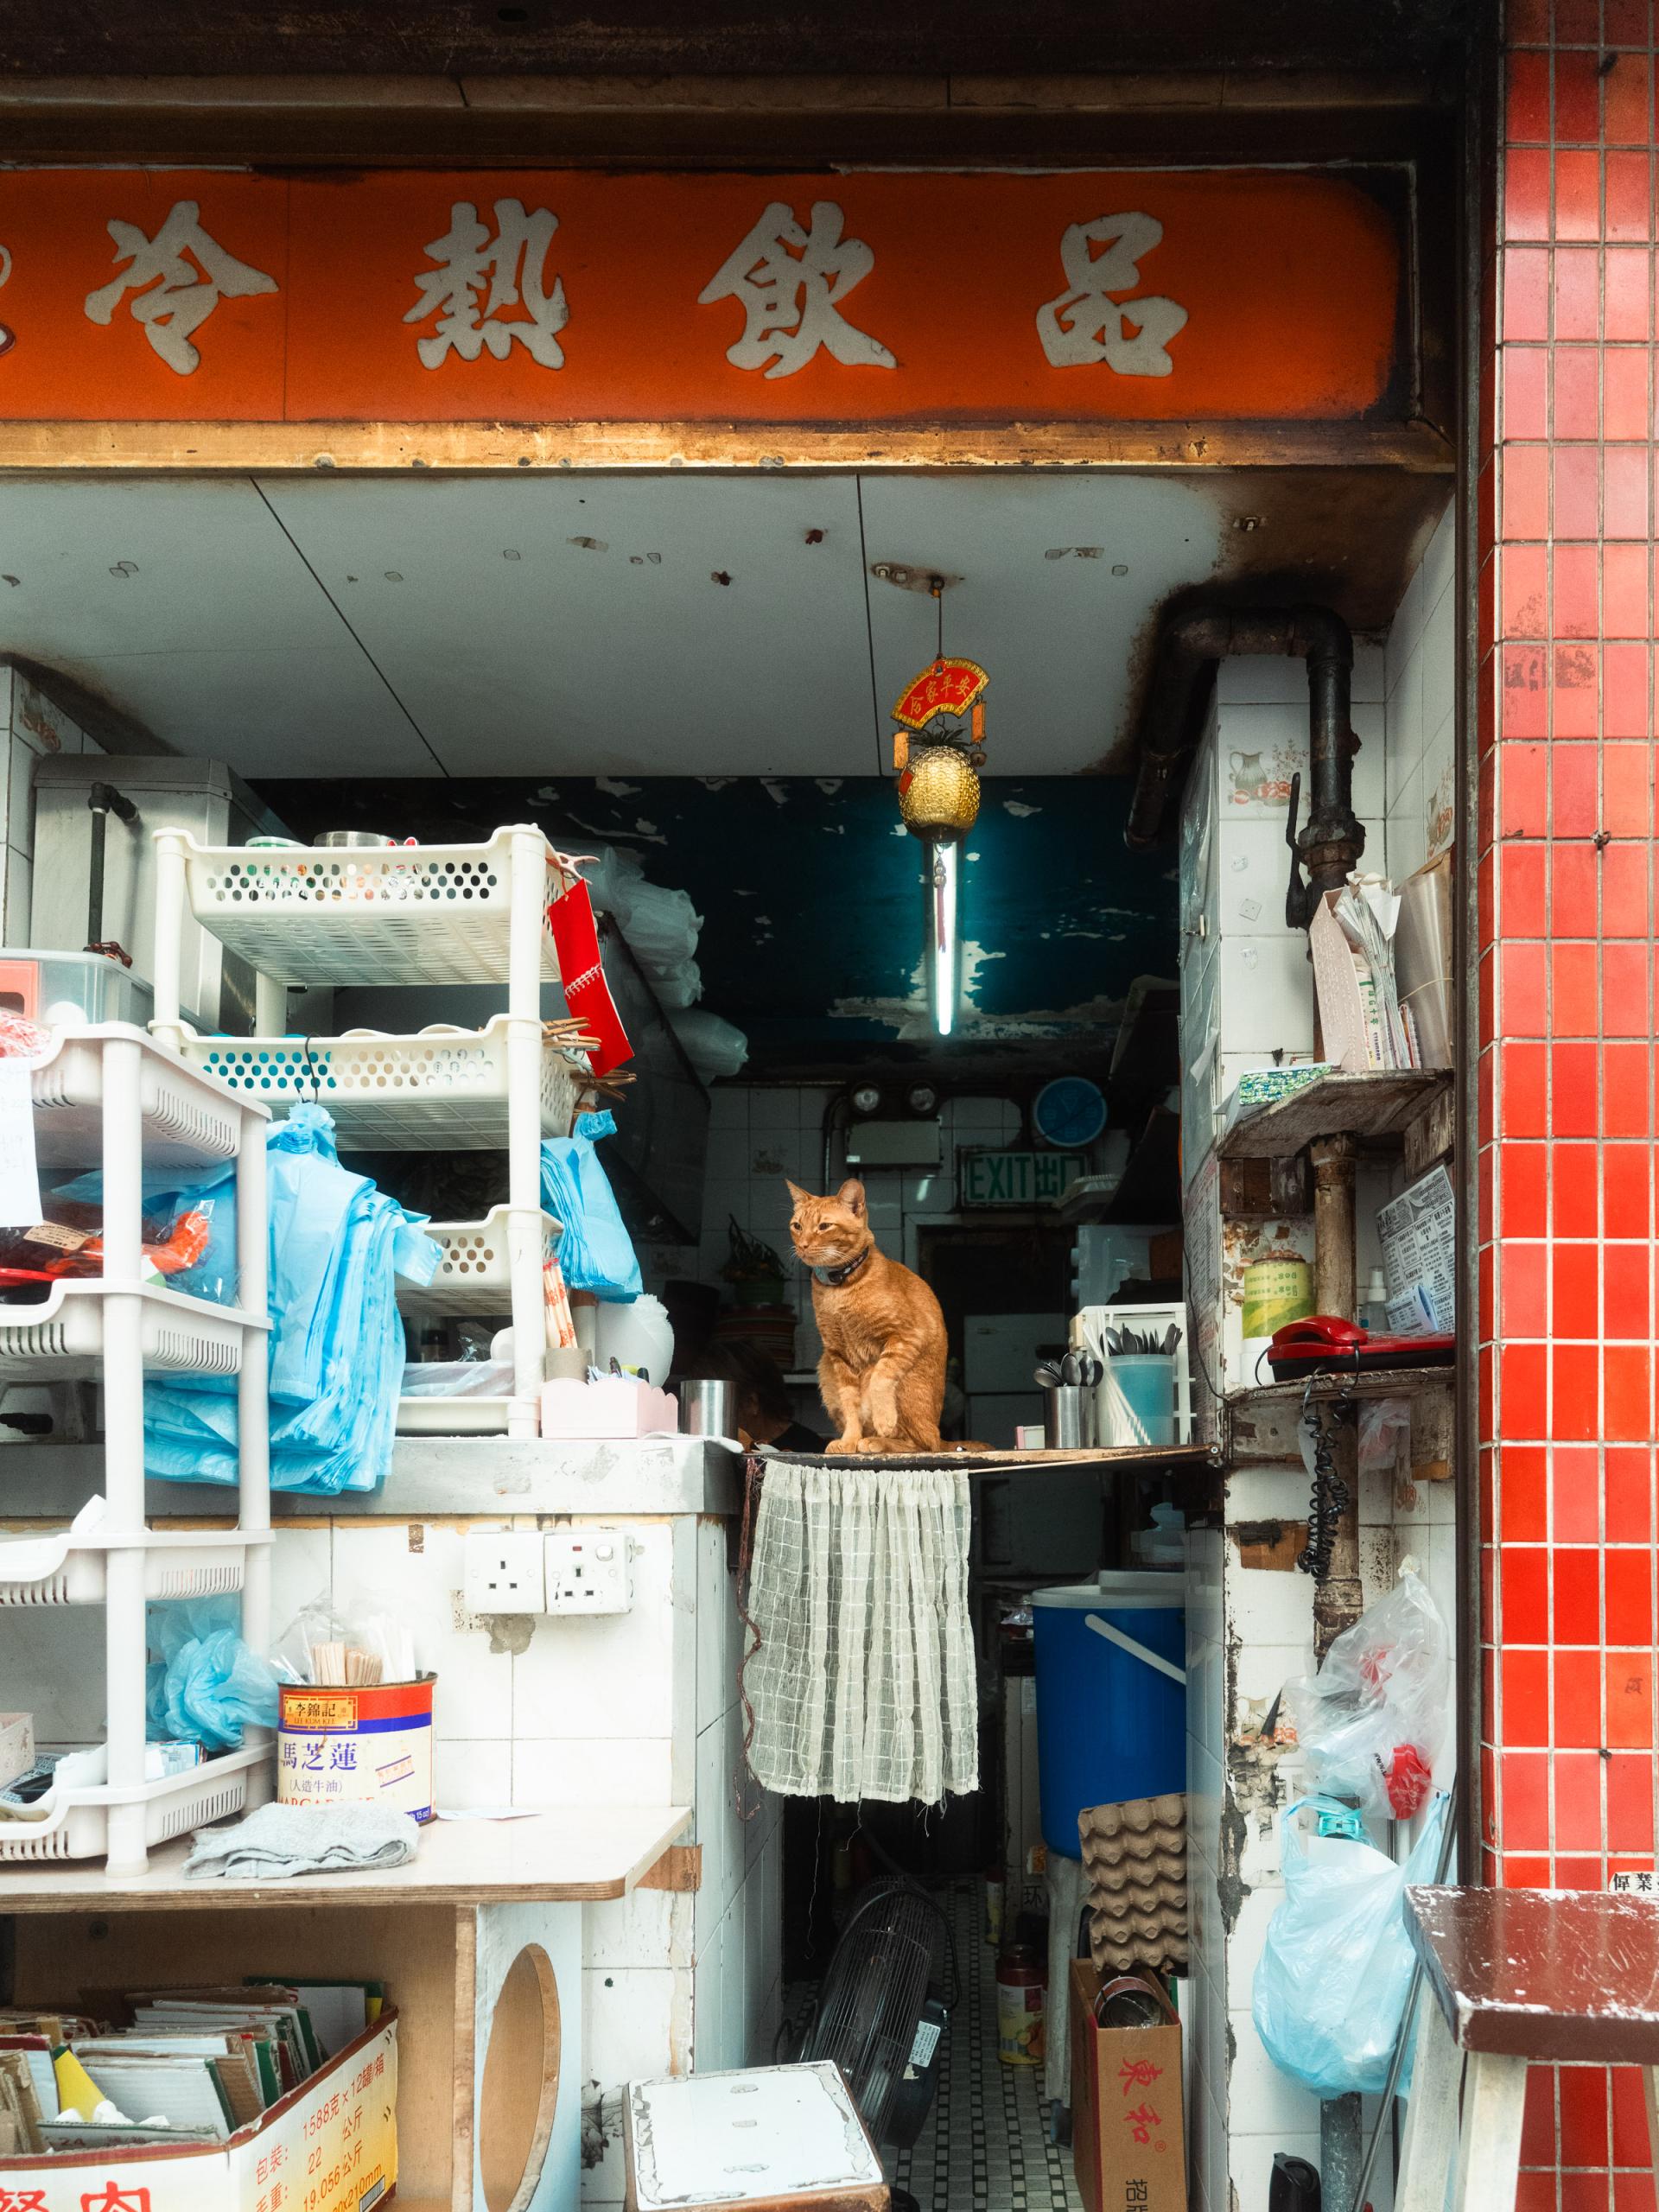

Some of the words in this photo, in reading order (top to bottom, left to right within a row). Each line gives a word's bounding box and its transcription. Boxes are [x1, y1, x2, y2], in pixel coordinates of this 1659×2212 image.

[84, 198, 1190, 379] 冷熱飲品
[969, 1156, 1031, 1199] EXIT
[1035, 1155, 1085, 1198] 出口
[296, 1702, 336, 1718] 李錦記
[282, 1742, 359, 1771] 馬芝蓮
[1118, 2056, 1163, 2145] 東和
[308, 2145, 322, 2176] 22
